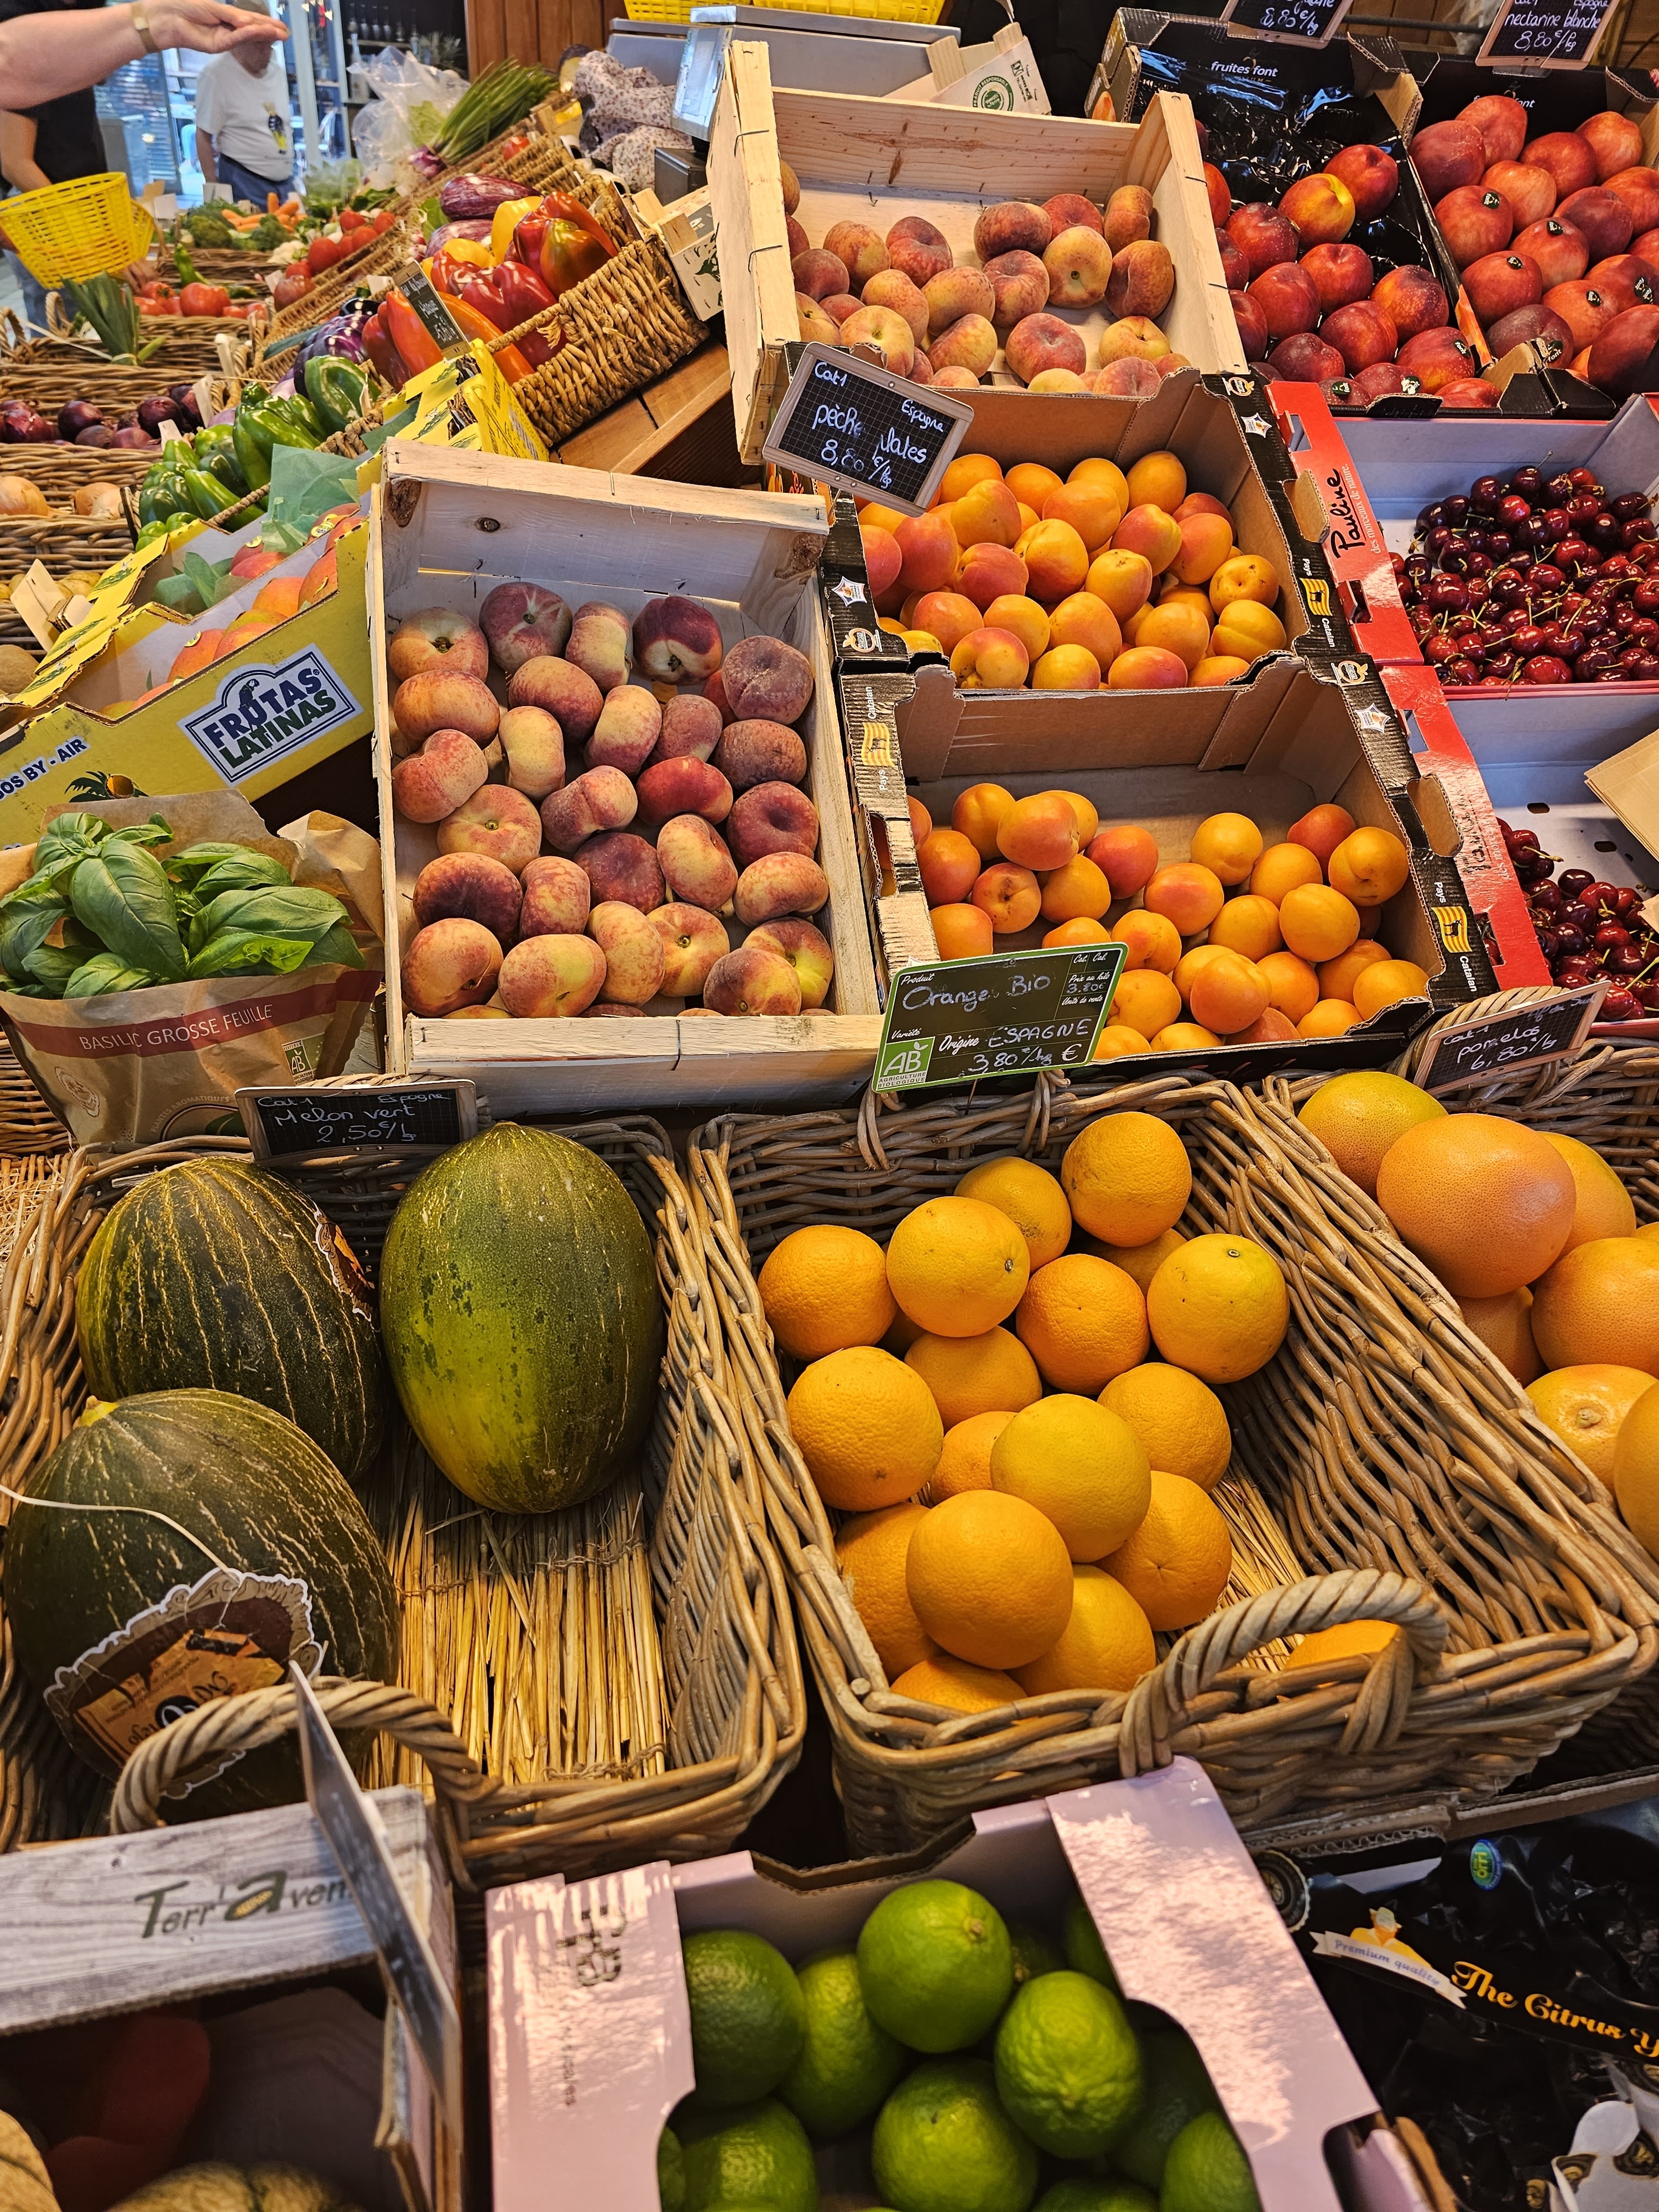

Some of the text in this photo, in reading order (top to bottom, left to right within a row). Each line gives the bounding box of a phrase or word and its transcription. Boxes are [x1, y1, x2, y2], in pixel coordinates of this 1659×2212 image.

[1504, 8, 1601, 28] nectarine blanche
[1211, 61, 1279, 77] fruites font
[901, 399, 945, 433] Espagne
[1350, 489, 1361, 500] de
[1327, 468, 1366, 559] Pauline
[1355, 500, 1378, 540] morceaux
[1370, 540, 1381, 554] des
[1302, 558, 1335, 648] Pays Catalan
[202, 668, 322, 749] FRUTAS
[219, 690, 336, 769] LATINAS
[865, 686, 888, 790] Pays Catalan
[23, 760, 46, 781] BY
[57, 739, 87, 762] AIR
[1434, 881, 1477, 992] Pays Catalan
[1073, 952, 1108, 964] Cat. Cal.
[901, 973, 935, 985] Produit
[1068, 974, 1085, 984] Prix
[1097, 972, 1110, 980] kilo
[1062, 997, 1079, 1006] Unité
[1088, 994, 1103, 1003] vente
[79, 1004, 273, 1050] BASILIC GROSSE FEUILLE
[891, 1028, 922, 1040] Variété
[939, 1018, 1092, 1055] Origine ESPAGNE
[1457, 1026, 1540, 1063] pomelos
[291, 1056, 306, 1074] AB
[879, 1072, 926, 1083] AGRICULTURE
[883, 1051, 921, 1075] AB
[877, 1077, 926, 1088] BIOLOGIQUE
[378, 1093, 451, 1104] Espagne
[150, 1095, 229, 1132] PLANTES AROMATIQUES
[274, 1104, 416, 1126] Melon vert
[1334, 1939, 1440, 1986] Premium quality
[1451, 1961, 1519, 2008] The
[1525, 1993, 1626, 2039] Citrus
